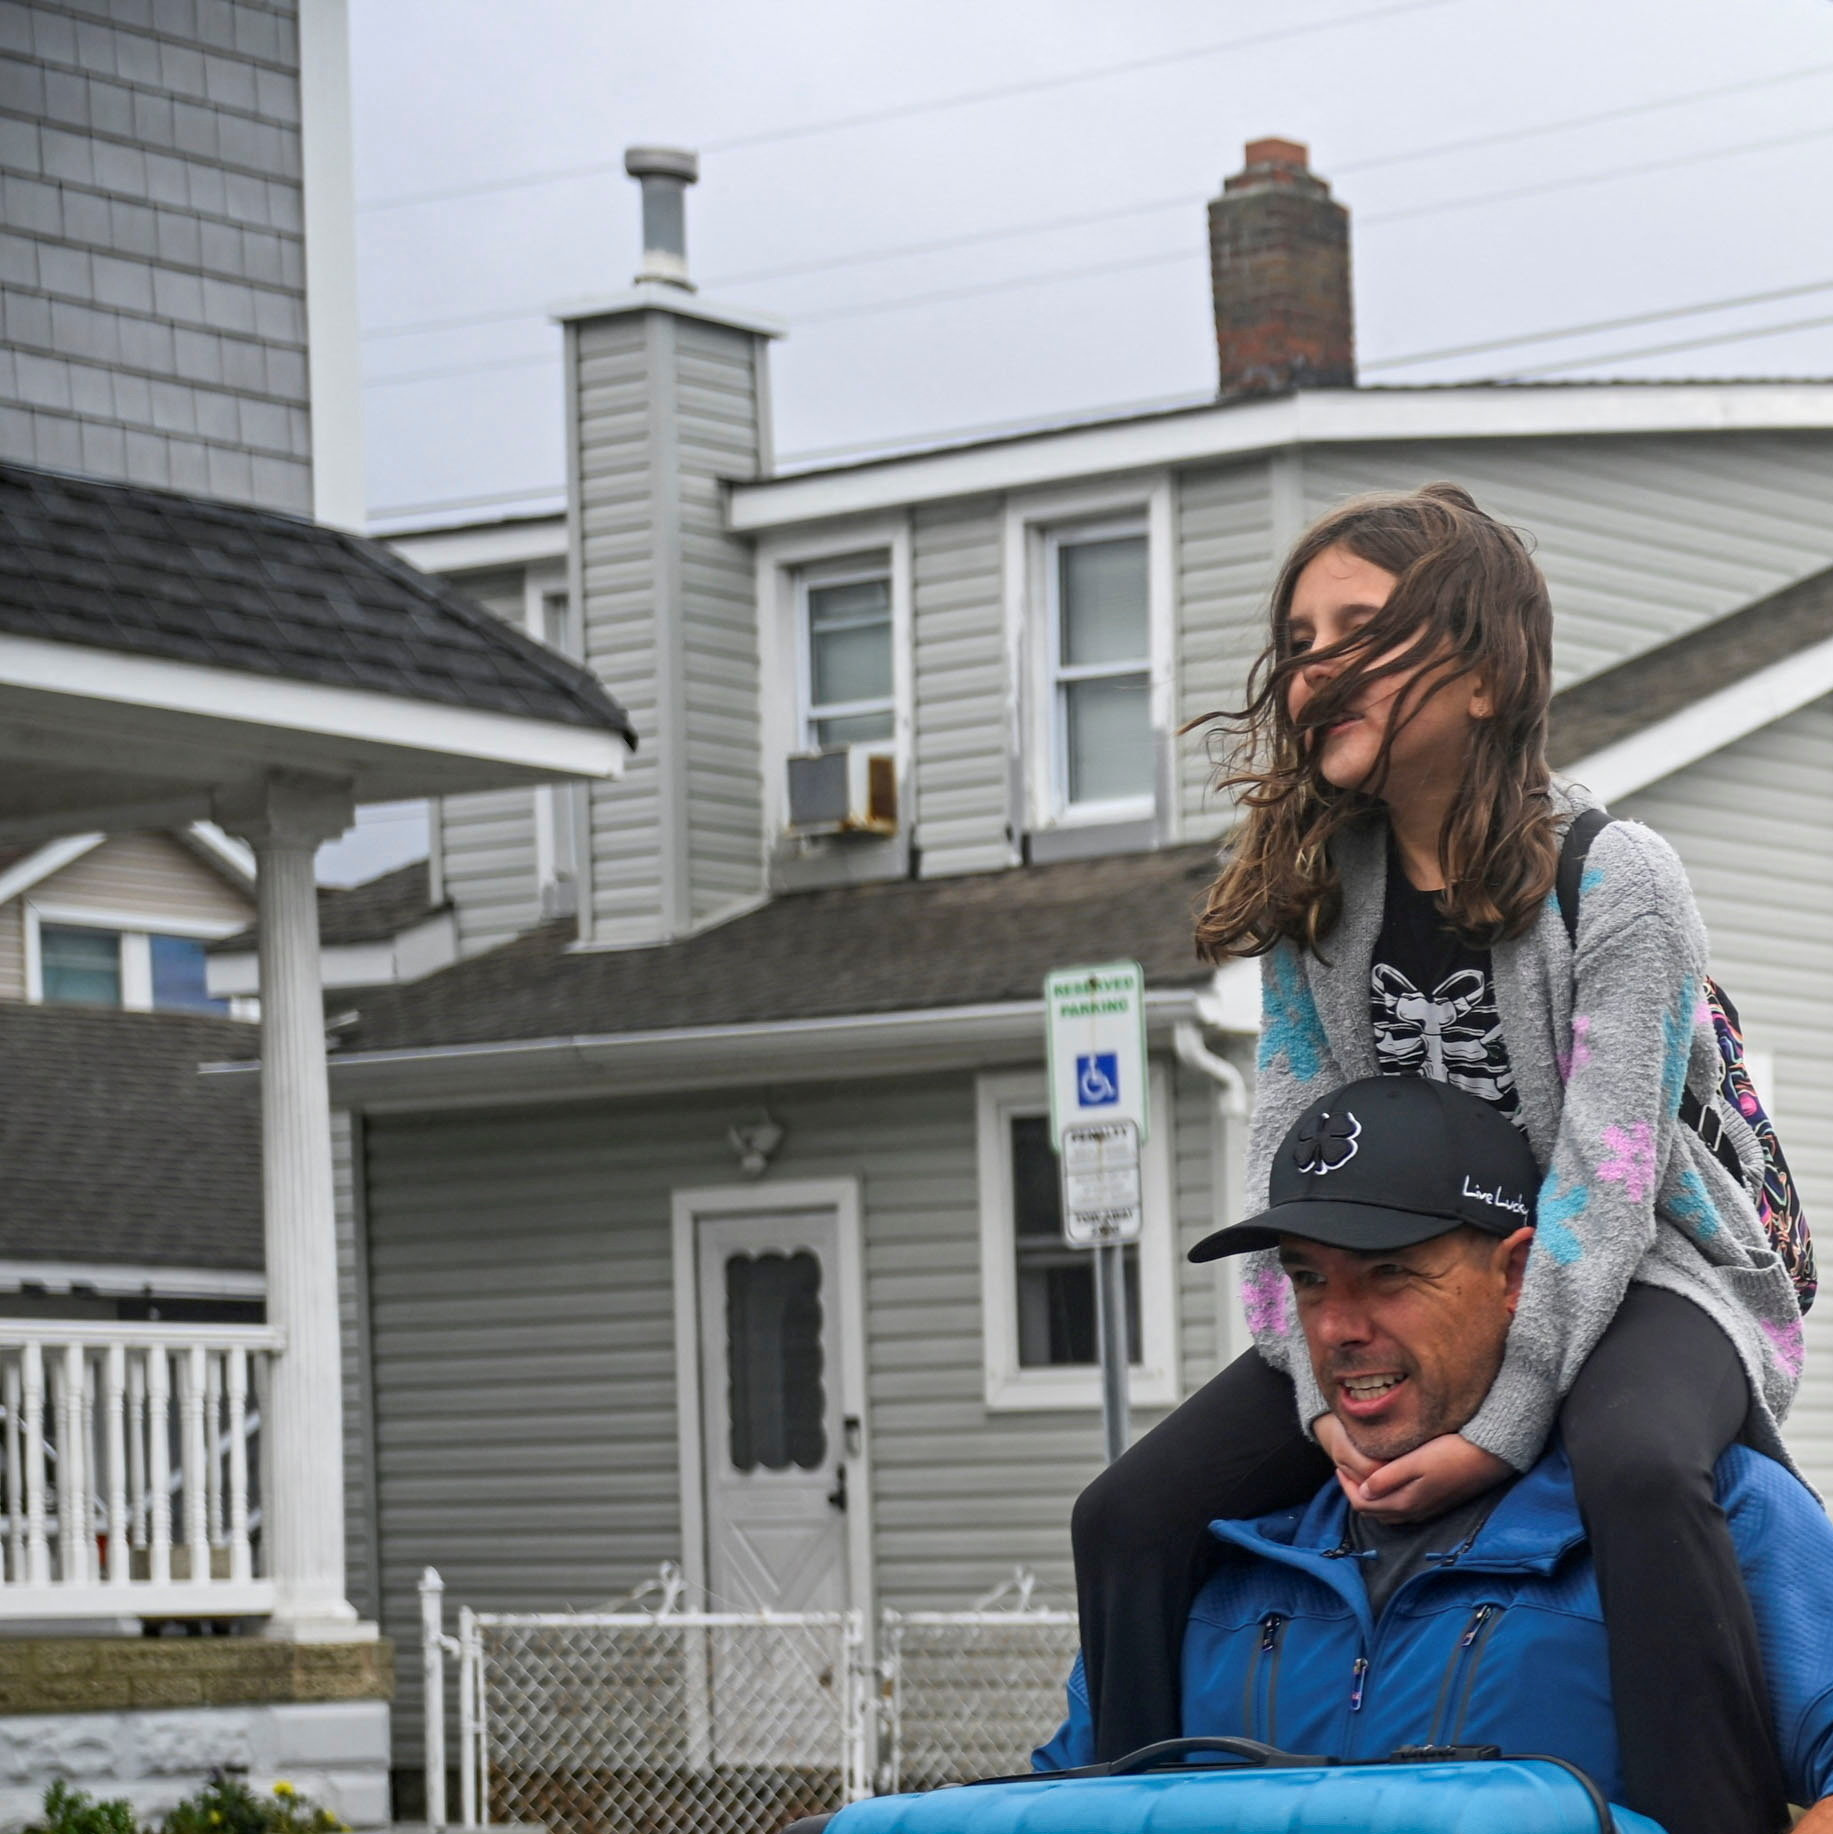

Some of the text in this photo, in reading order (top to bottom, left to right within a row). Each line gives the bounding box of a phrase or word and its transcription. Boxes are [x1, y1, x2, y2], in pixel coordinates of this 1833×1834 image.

[1054, 975, 1134, 997] RESERVED
[1060, 999, 1129, 1017] PARKING
[1462, 1174, 1494, 1205] Live
